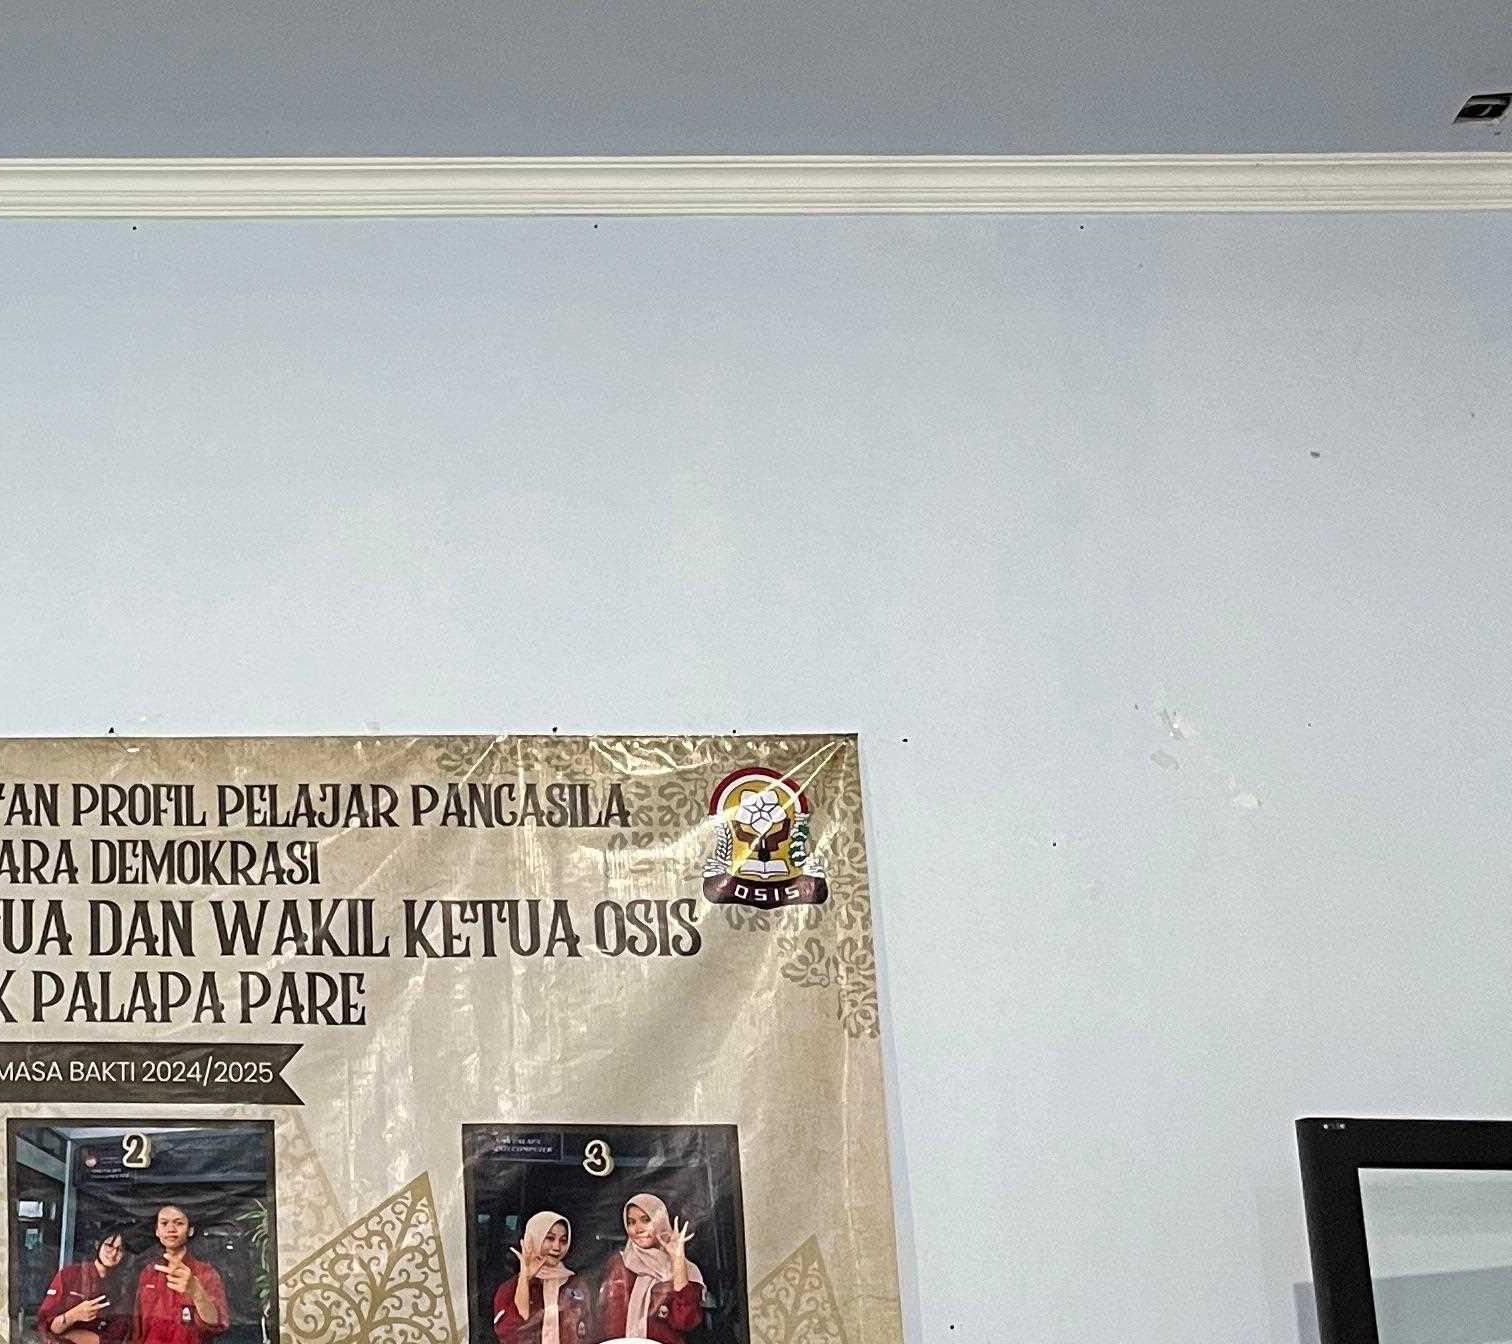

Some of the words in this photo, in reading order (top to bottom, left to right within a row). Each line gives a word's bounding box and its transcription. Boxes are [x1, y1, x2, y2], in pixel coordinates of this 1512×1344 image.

[72, 783, 207, 827] PROFIL
[217, 783, 399, 828] PELAJAR
[412, 782, 631, 828] PANCASILA
[91, 839, 320, 886] DEMOKRASI
[734, 884, 800, 901] OSIS
[89, 899, 196, 957] DAN
[210, 898, 390, 957] WAKIL
[403, 898, 582, 958] KETUA
[594, 897, 702, 957] OSIS
[31, 970, 225, 1024] PALAPA
[239, 971, 366, 1026] PARE
[69, 1061, 136, 1082] BAKTI
[142, 1056, 274, 1086] 2024/2025
[122, 1133, 152, 1168] 2
[582, 1139, 615, 1176] 3
